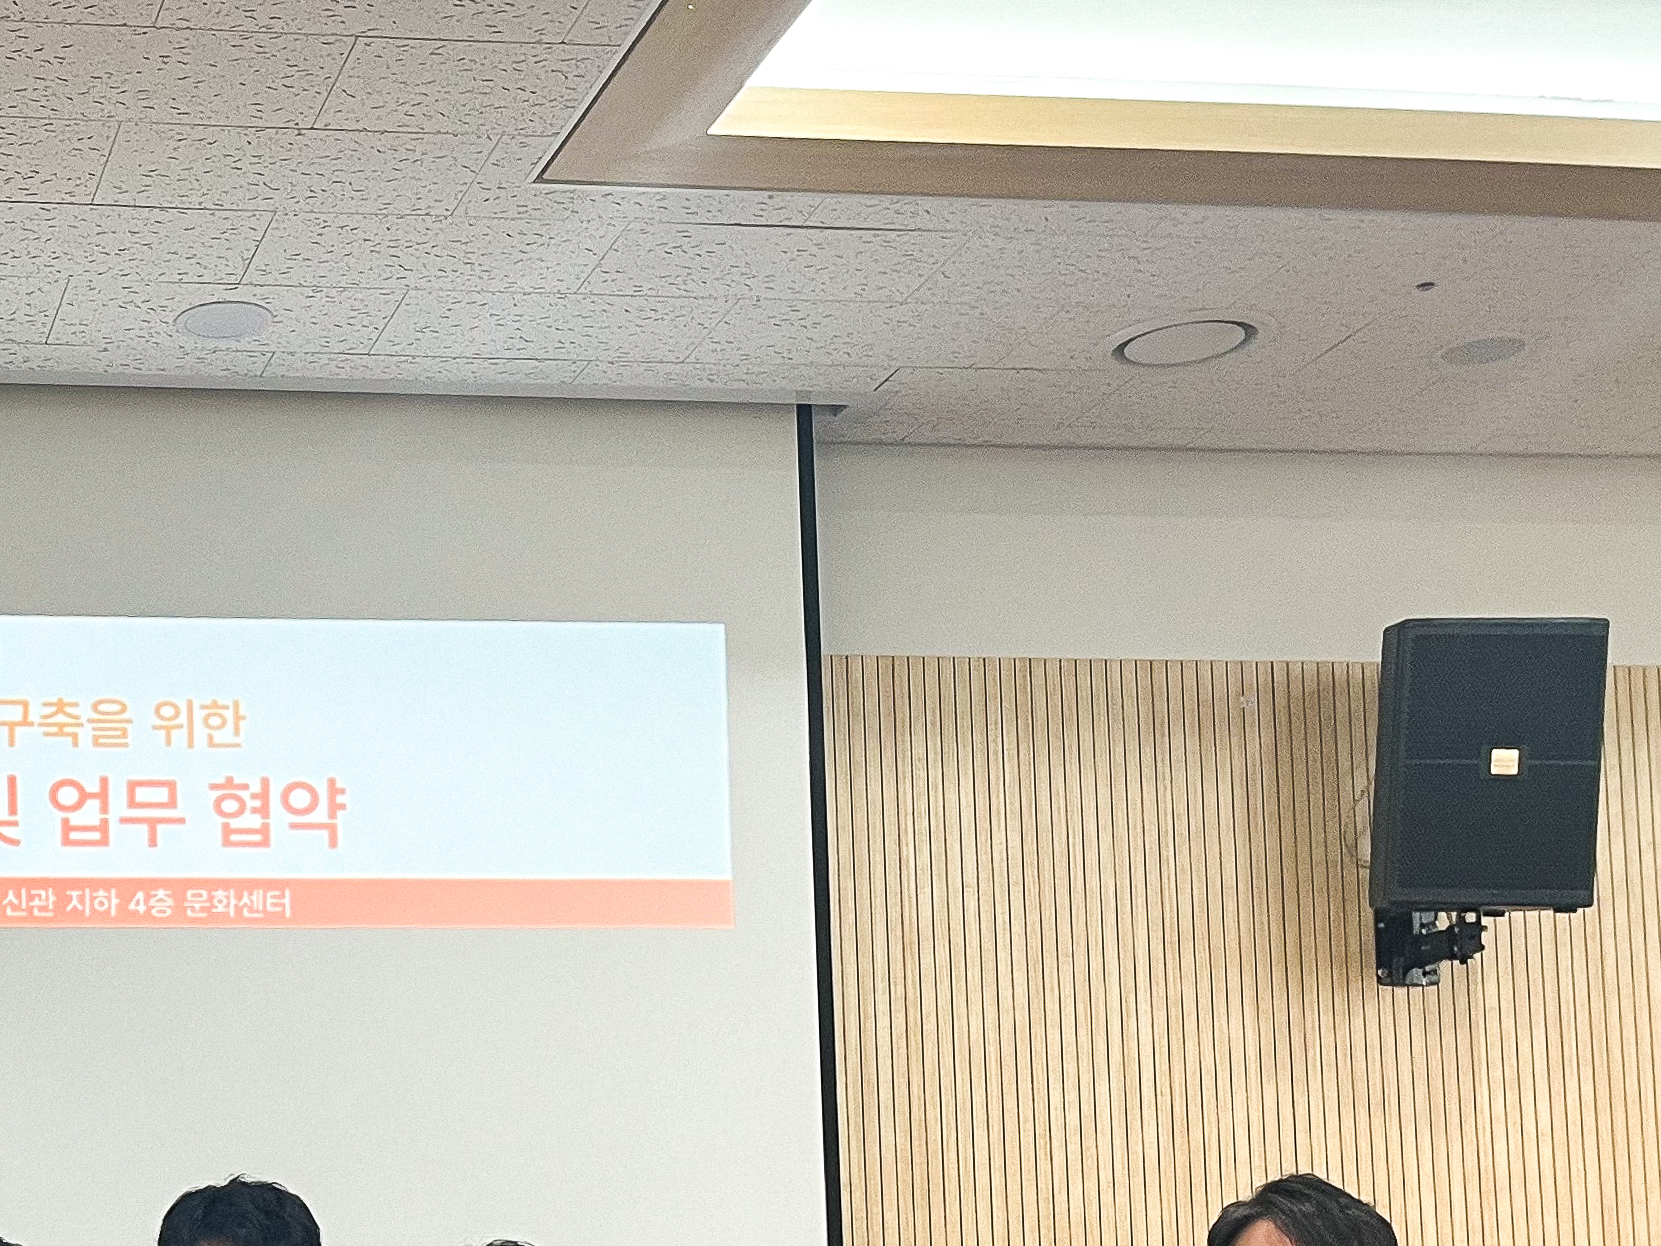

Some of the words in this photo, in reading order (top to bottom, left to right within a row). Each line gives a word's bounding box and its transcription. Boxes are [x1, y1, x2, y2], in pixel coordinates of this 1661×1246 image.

[152, 698, 246, 750] 위한
[48, 775, 186, 848] 업무
[208, 775, 347, 849] 협약
[2, 888, 56, 917] 신관
[65, 888, 120, 918] 지하
[128, 888, 174, 918] 4층
[183, 888, 291, 919] 문화센터
